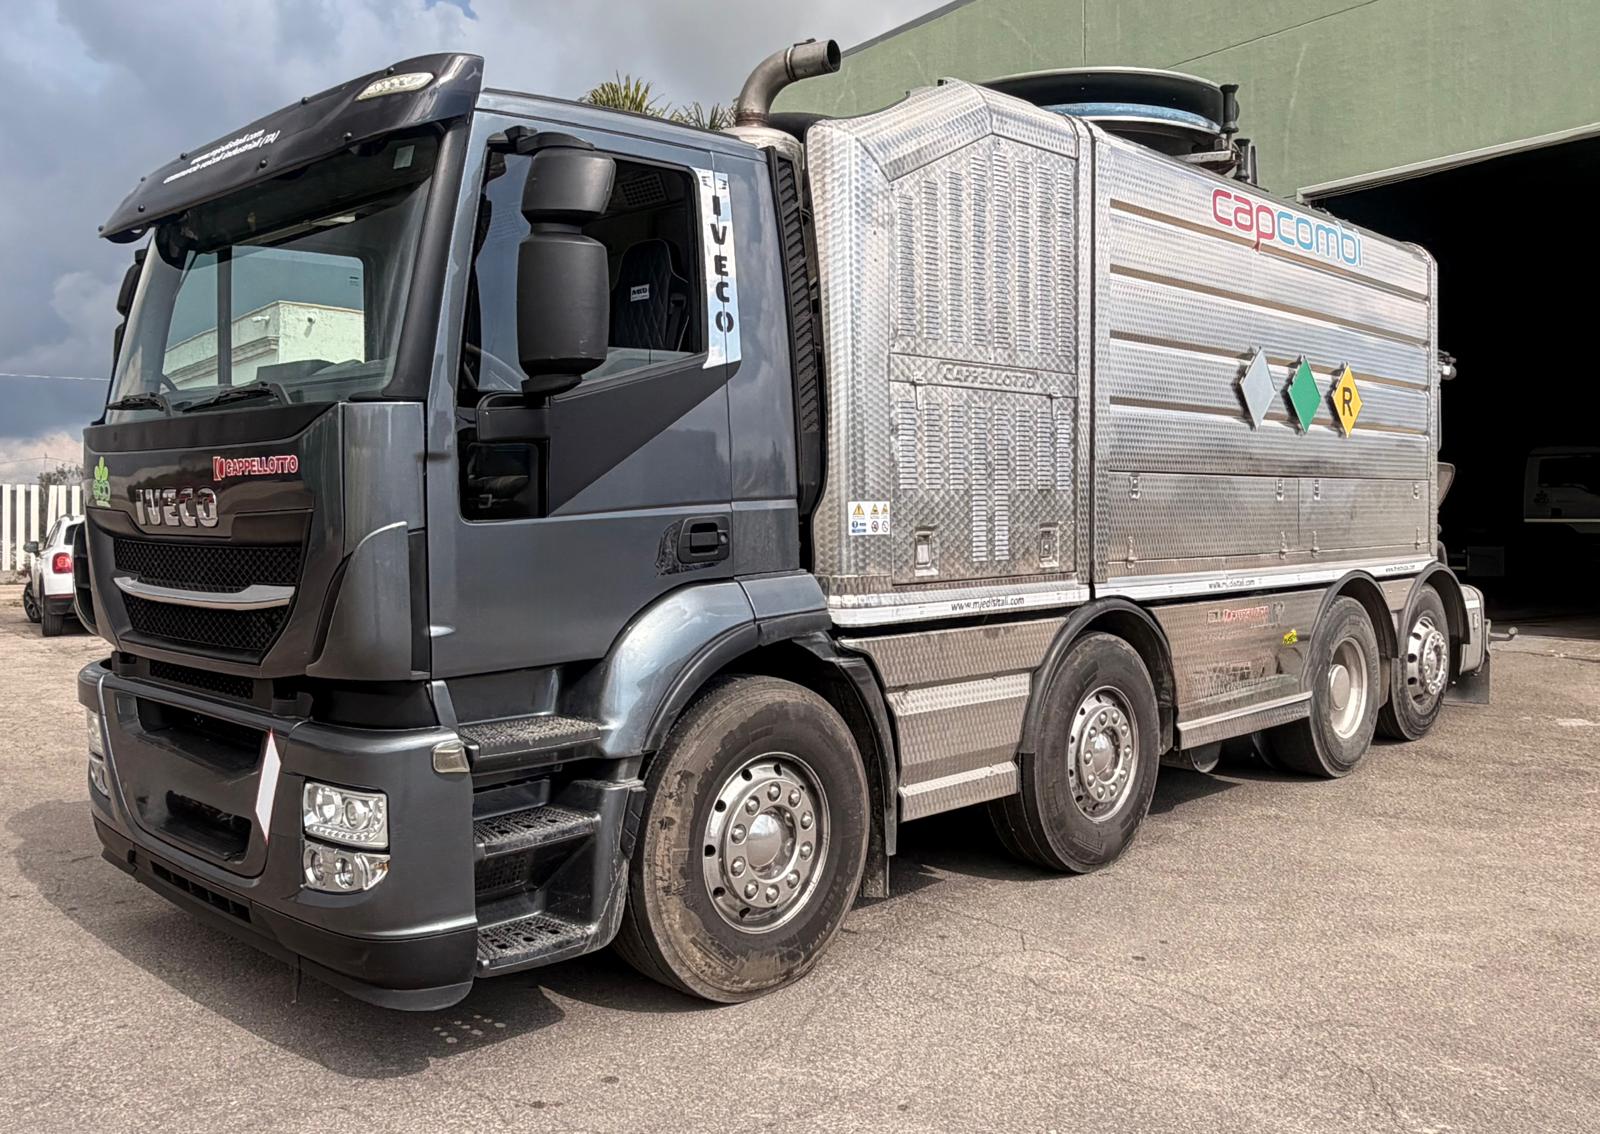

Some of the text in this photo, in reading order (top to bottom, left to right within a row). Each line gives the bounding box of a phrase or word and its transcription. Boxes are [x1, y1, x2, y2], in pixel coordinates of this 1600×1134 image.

[1212, 187, 1363, 267] capcombi
[710, 195, 735, 333] IVECO
[1342, 386, 1353, 417] R
[224, 454, 299, 477] CAPPELLOTTO
[135, 487, 219, 528] IVECO
